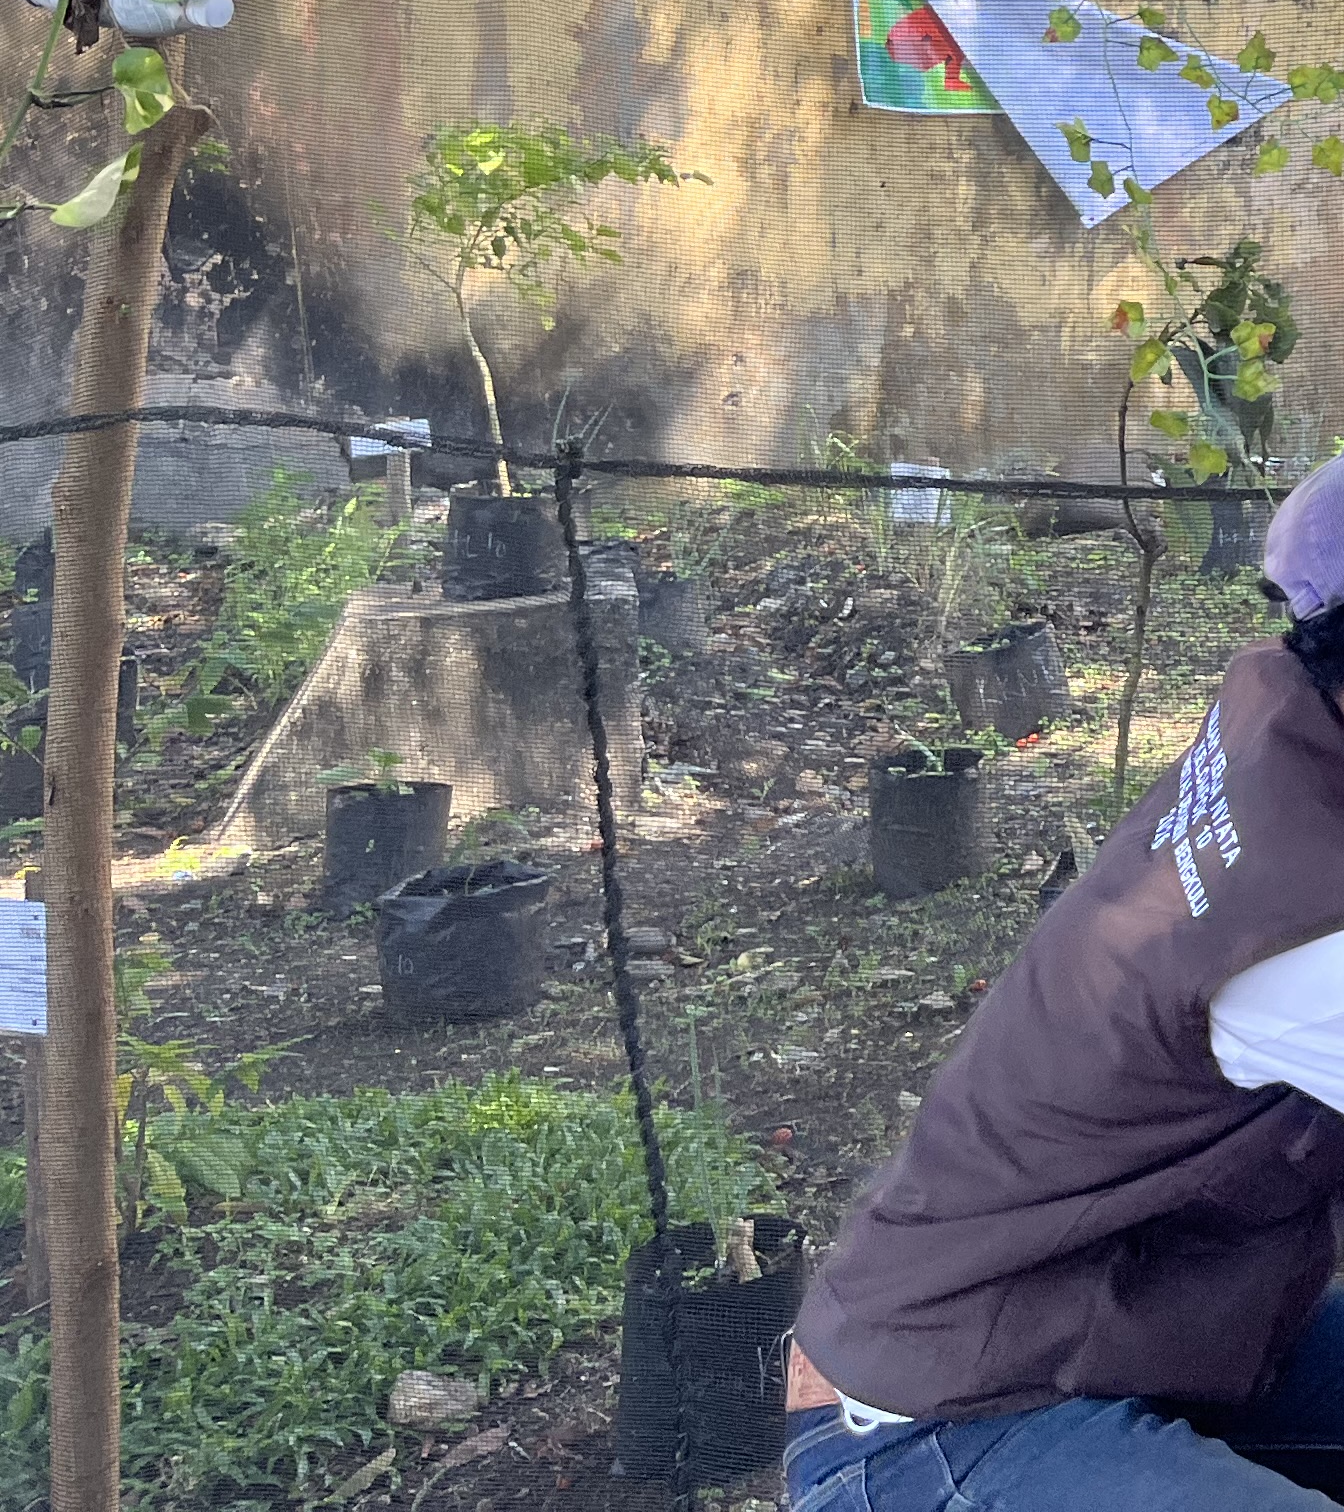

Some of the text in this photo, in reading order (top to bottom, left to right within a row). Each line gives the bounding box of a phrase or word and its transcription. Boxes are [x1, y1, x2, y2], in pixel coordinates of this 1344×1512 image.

[1196, 824, 1213, 849] 10
[1210, 796, 1241, 868] NYATA
[1174, 837, 1209, 918] BENGKULU
